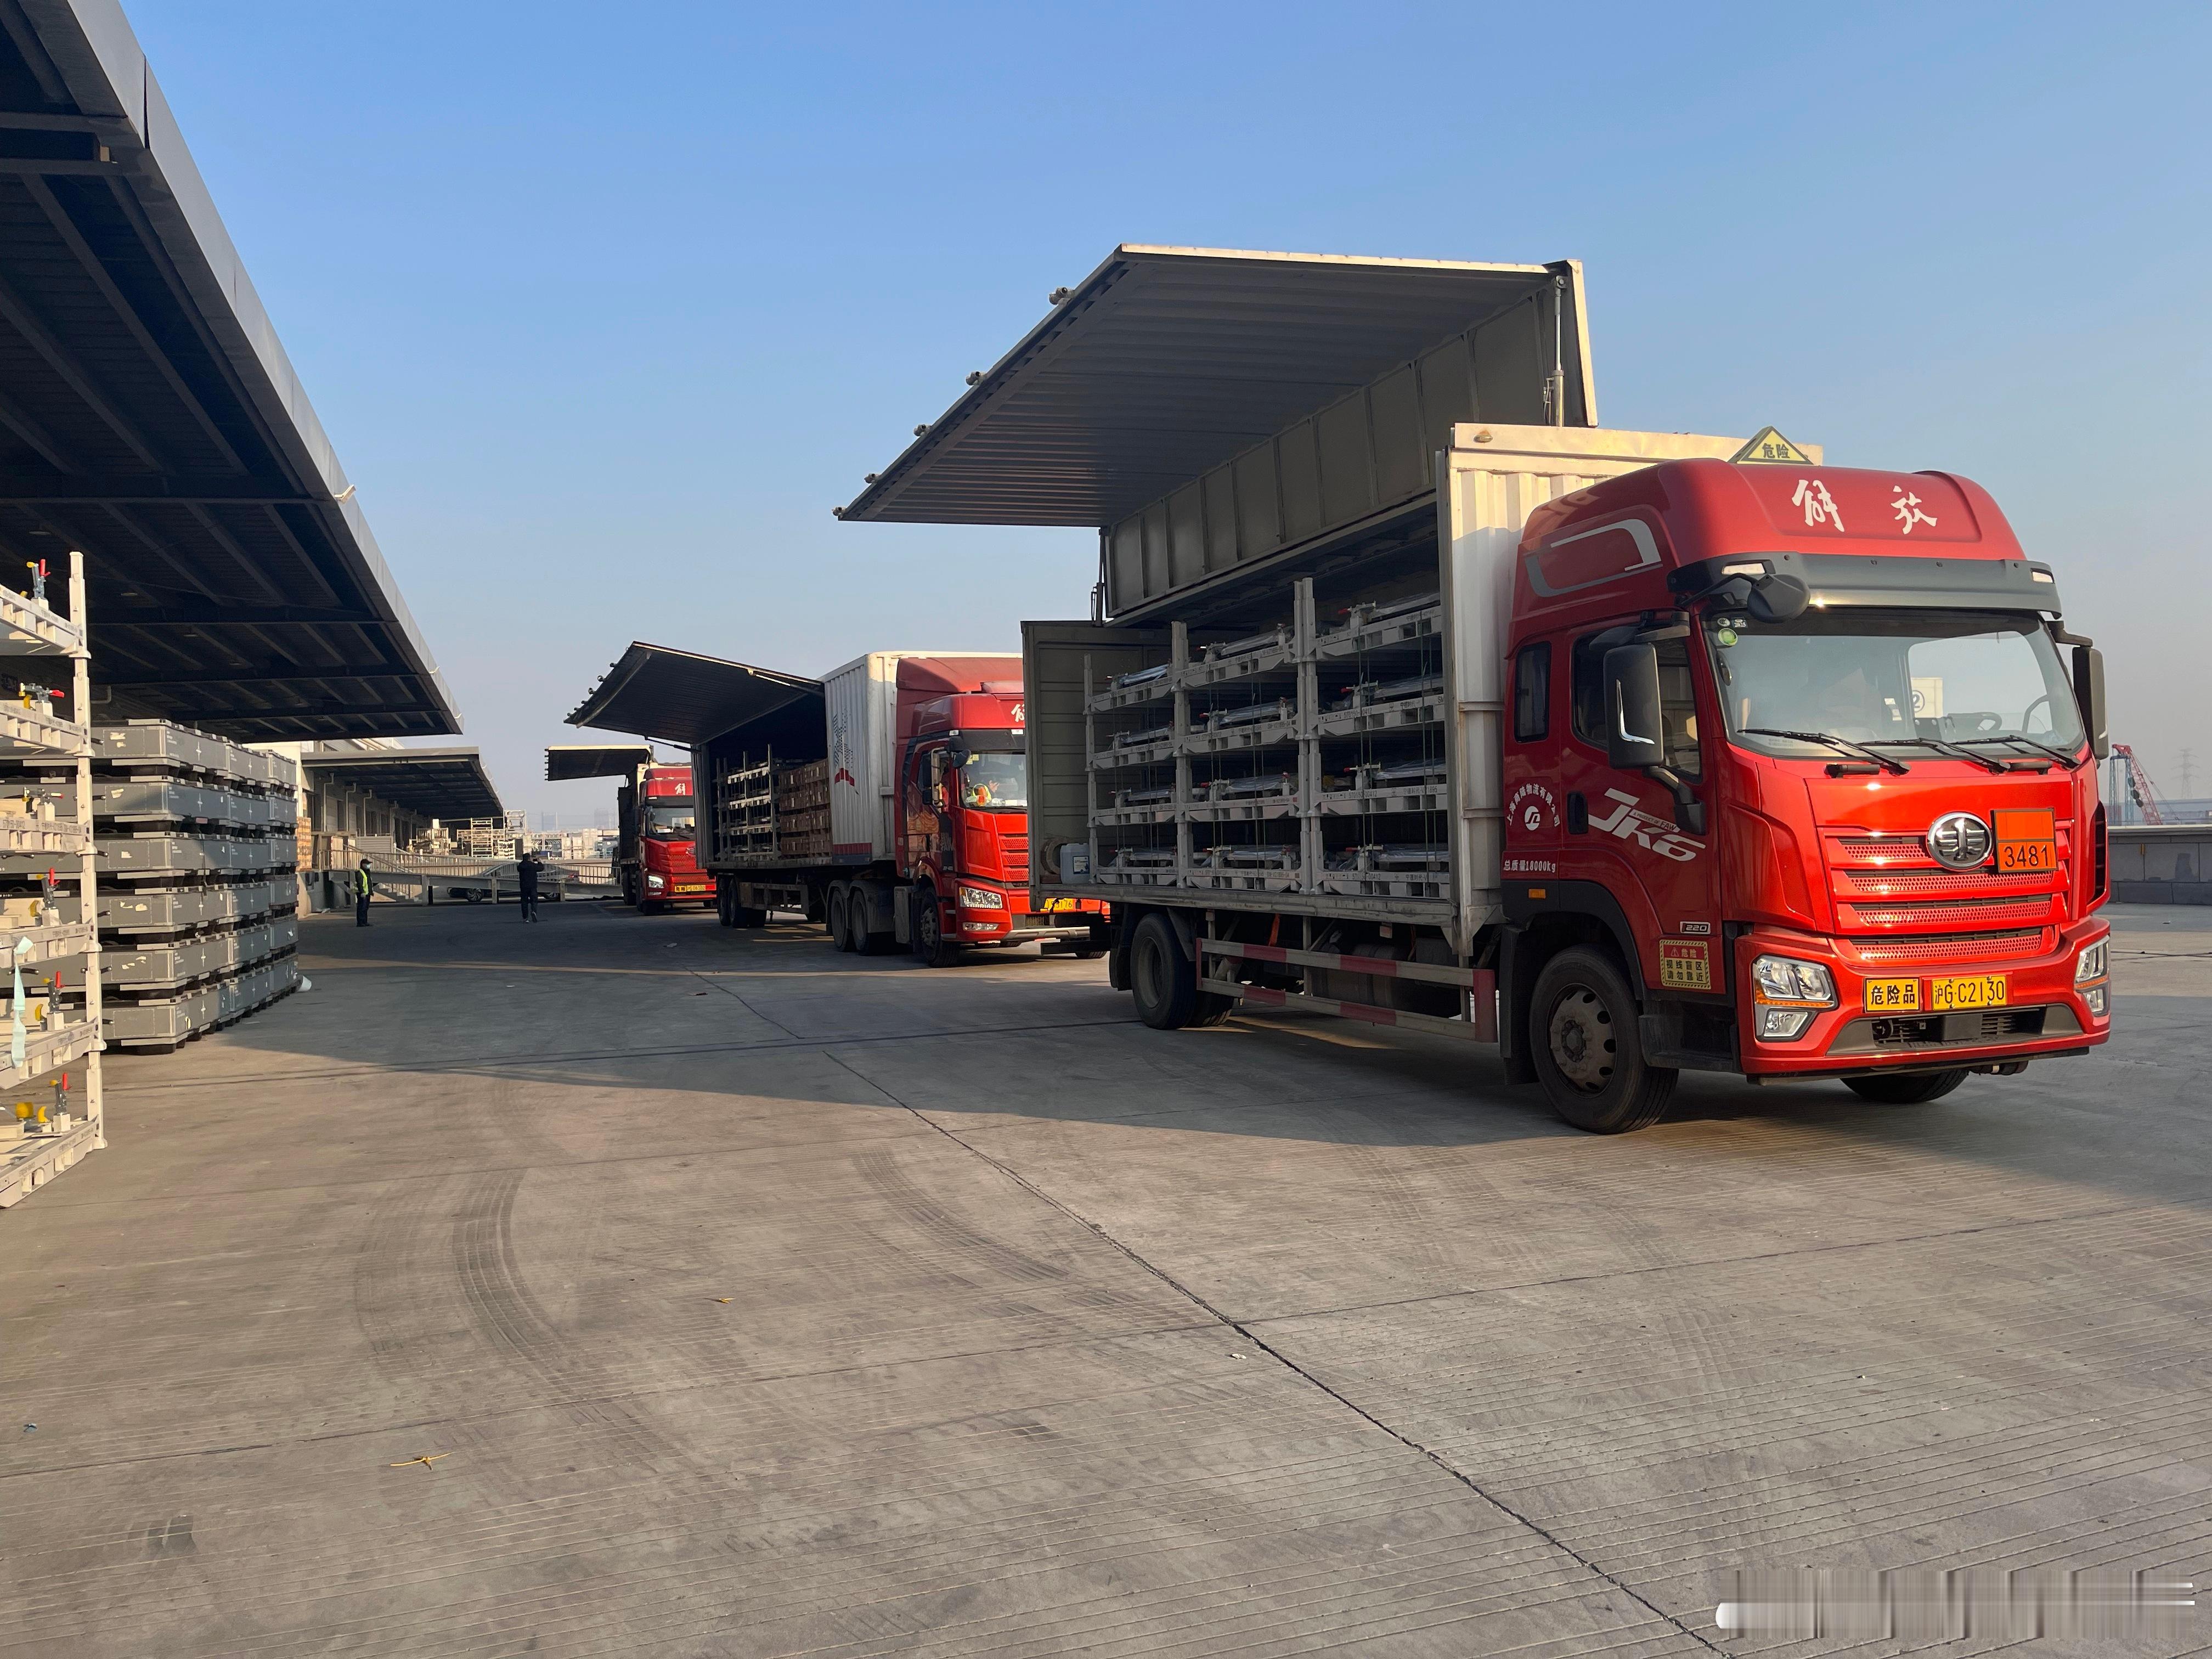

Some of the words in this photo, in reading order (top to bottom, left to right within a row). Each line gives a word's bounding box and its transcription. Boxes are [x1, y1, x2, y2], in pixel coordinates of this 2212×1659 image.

[1762, 443, 1790, 459] 危险
[1660, 821, 1677, 831] FAW
[2004, 845, 2049, 867] 3481
[1503, 859, 1556, 873] 总质量18000kg
[1681, 948, 1697, 958] 危险
[1666, 960, 1702, 970] 视线盲区
[1667, 970, 1703, 981] 请勿靠近
[1871, 984, 1915, 1005] 危险品
